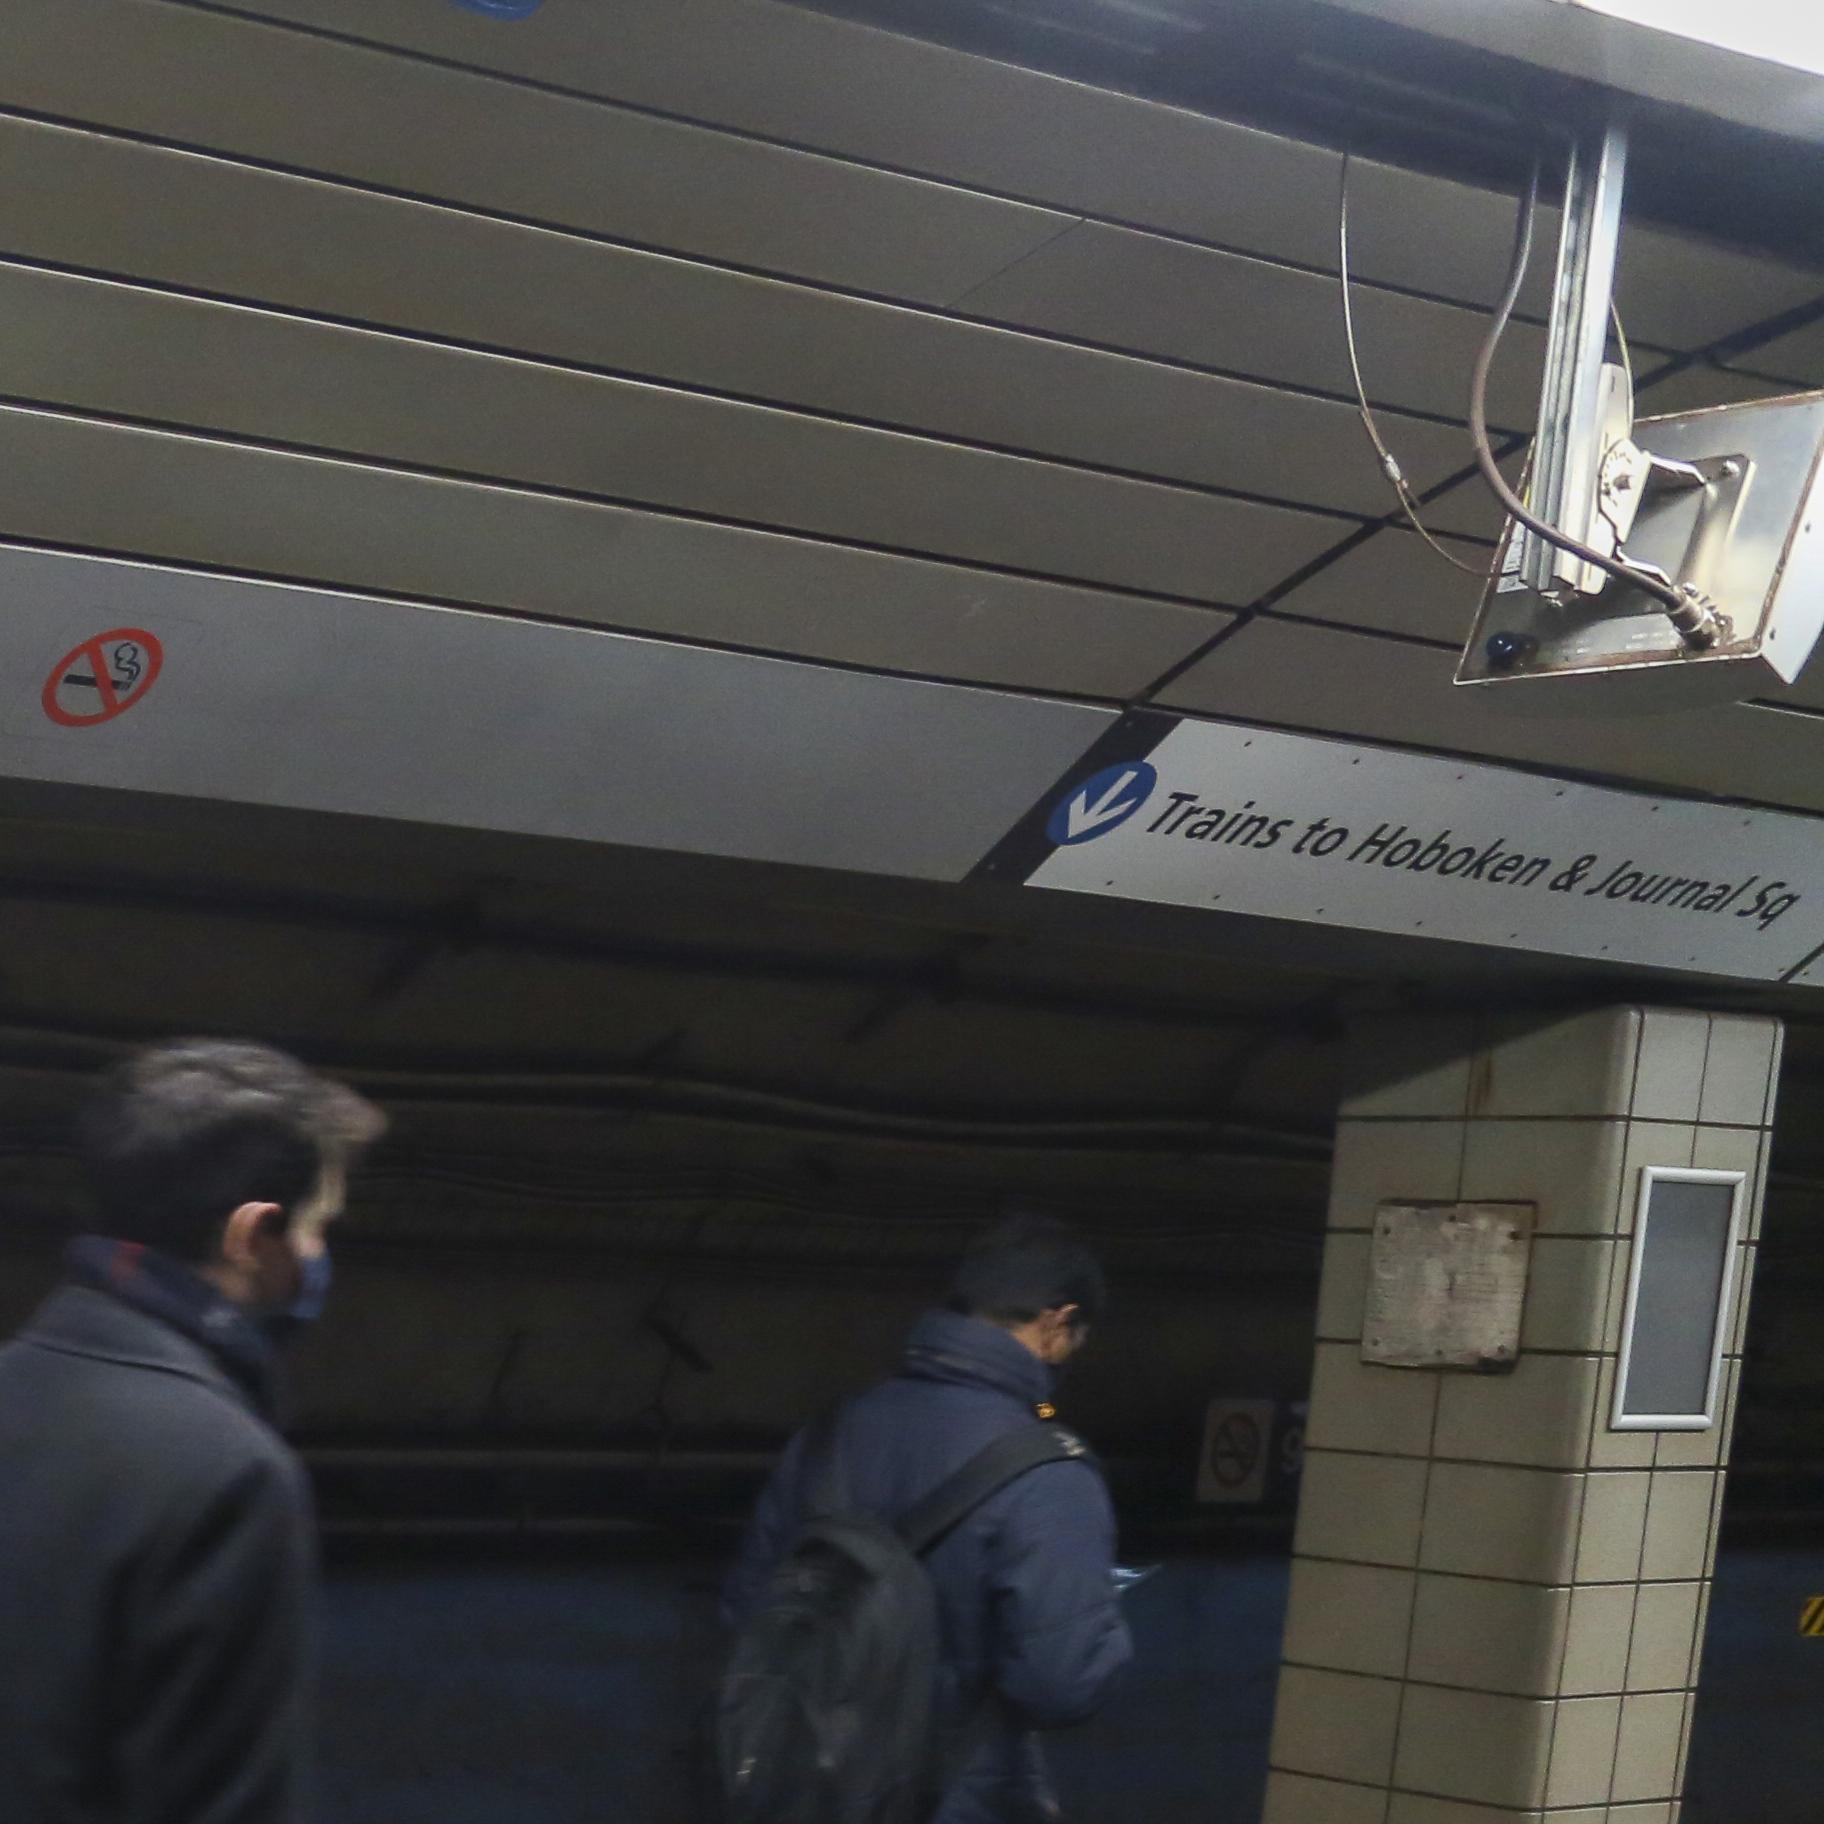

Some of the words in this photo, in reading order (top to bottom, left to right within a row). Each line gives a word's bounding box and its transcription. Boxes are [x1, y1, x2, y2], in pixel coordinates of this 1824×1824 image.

[1146, 792, 1294, 848] Trains
[1292, 817, 1349, 856] to
[1347, 823, 1553, 886] Hoboken
[1549, 854, 1598, 892] &
[1584, 860, 1759, 912] Journal
[1735, 881, 1801, 931] Sq
